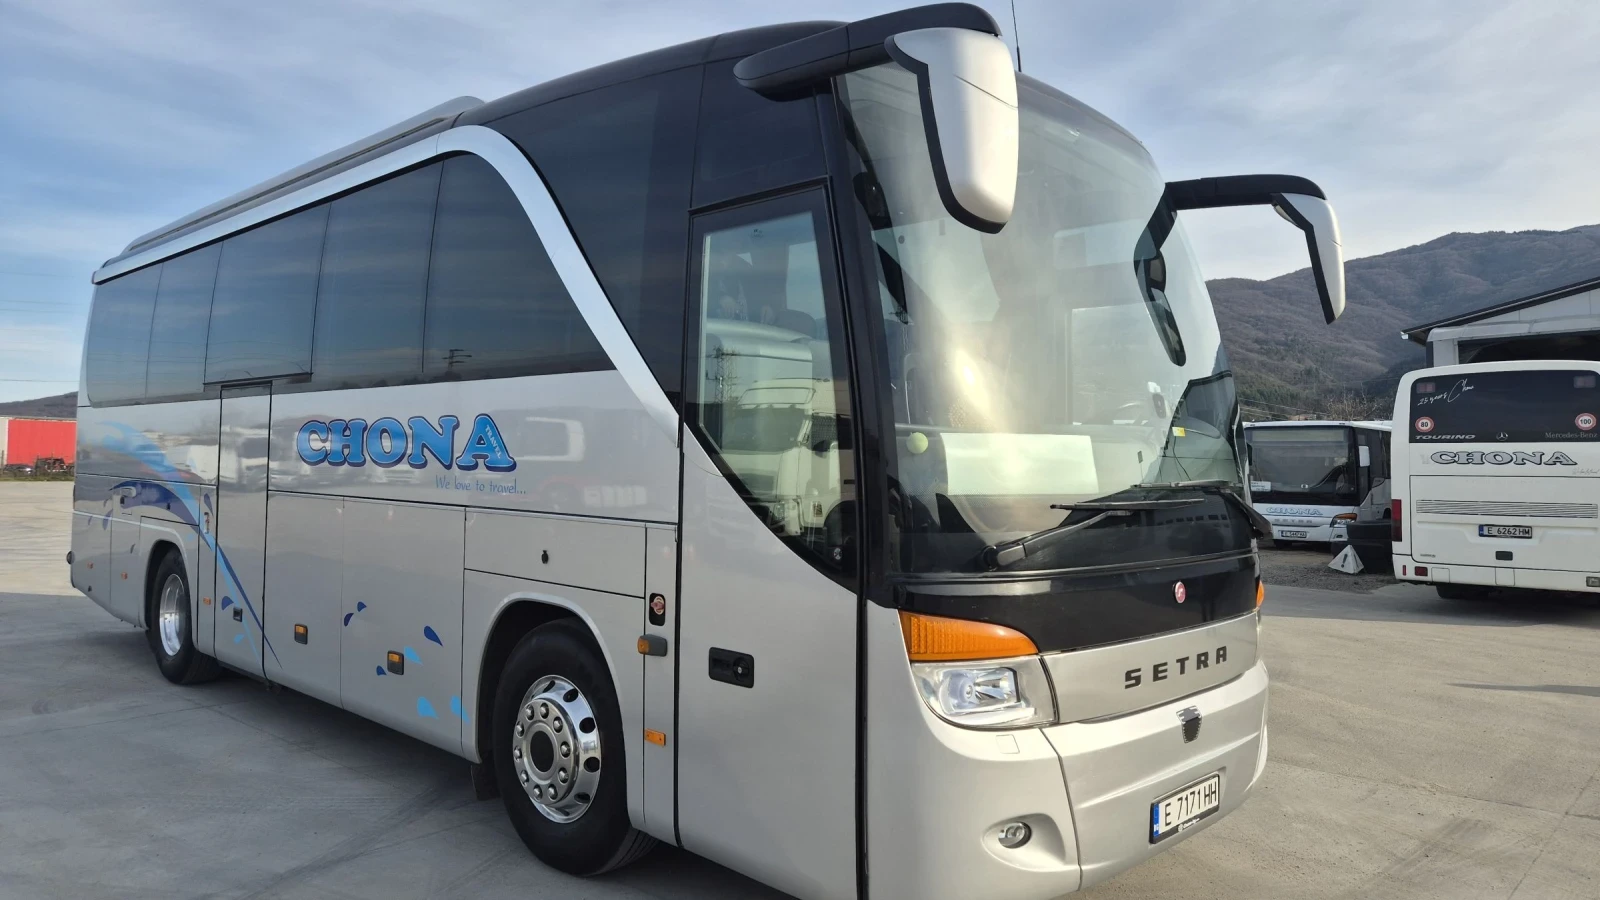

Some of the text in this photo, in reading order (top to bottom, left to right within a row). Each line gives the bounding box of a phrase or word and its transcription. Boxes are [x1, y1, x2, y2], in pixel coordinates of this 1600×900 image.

[296, 413, 517, 472] CHONA
[485, 424, 502, 459] TRAVEL
[1544, 431, 1598, 439] Mercedes-Benz
[1430, 450, 1578, 465] CHONA
[435, 475, 450, 490] We
[454, 475, 471, 491] love
[476, 479, 485, 492] to
[1487, 526, 1493, 535] E
[1124, 645, 1227, 689] SETRA
[1164, 802, 1171, 827] E
